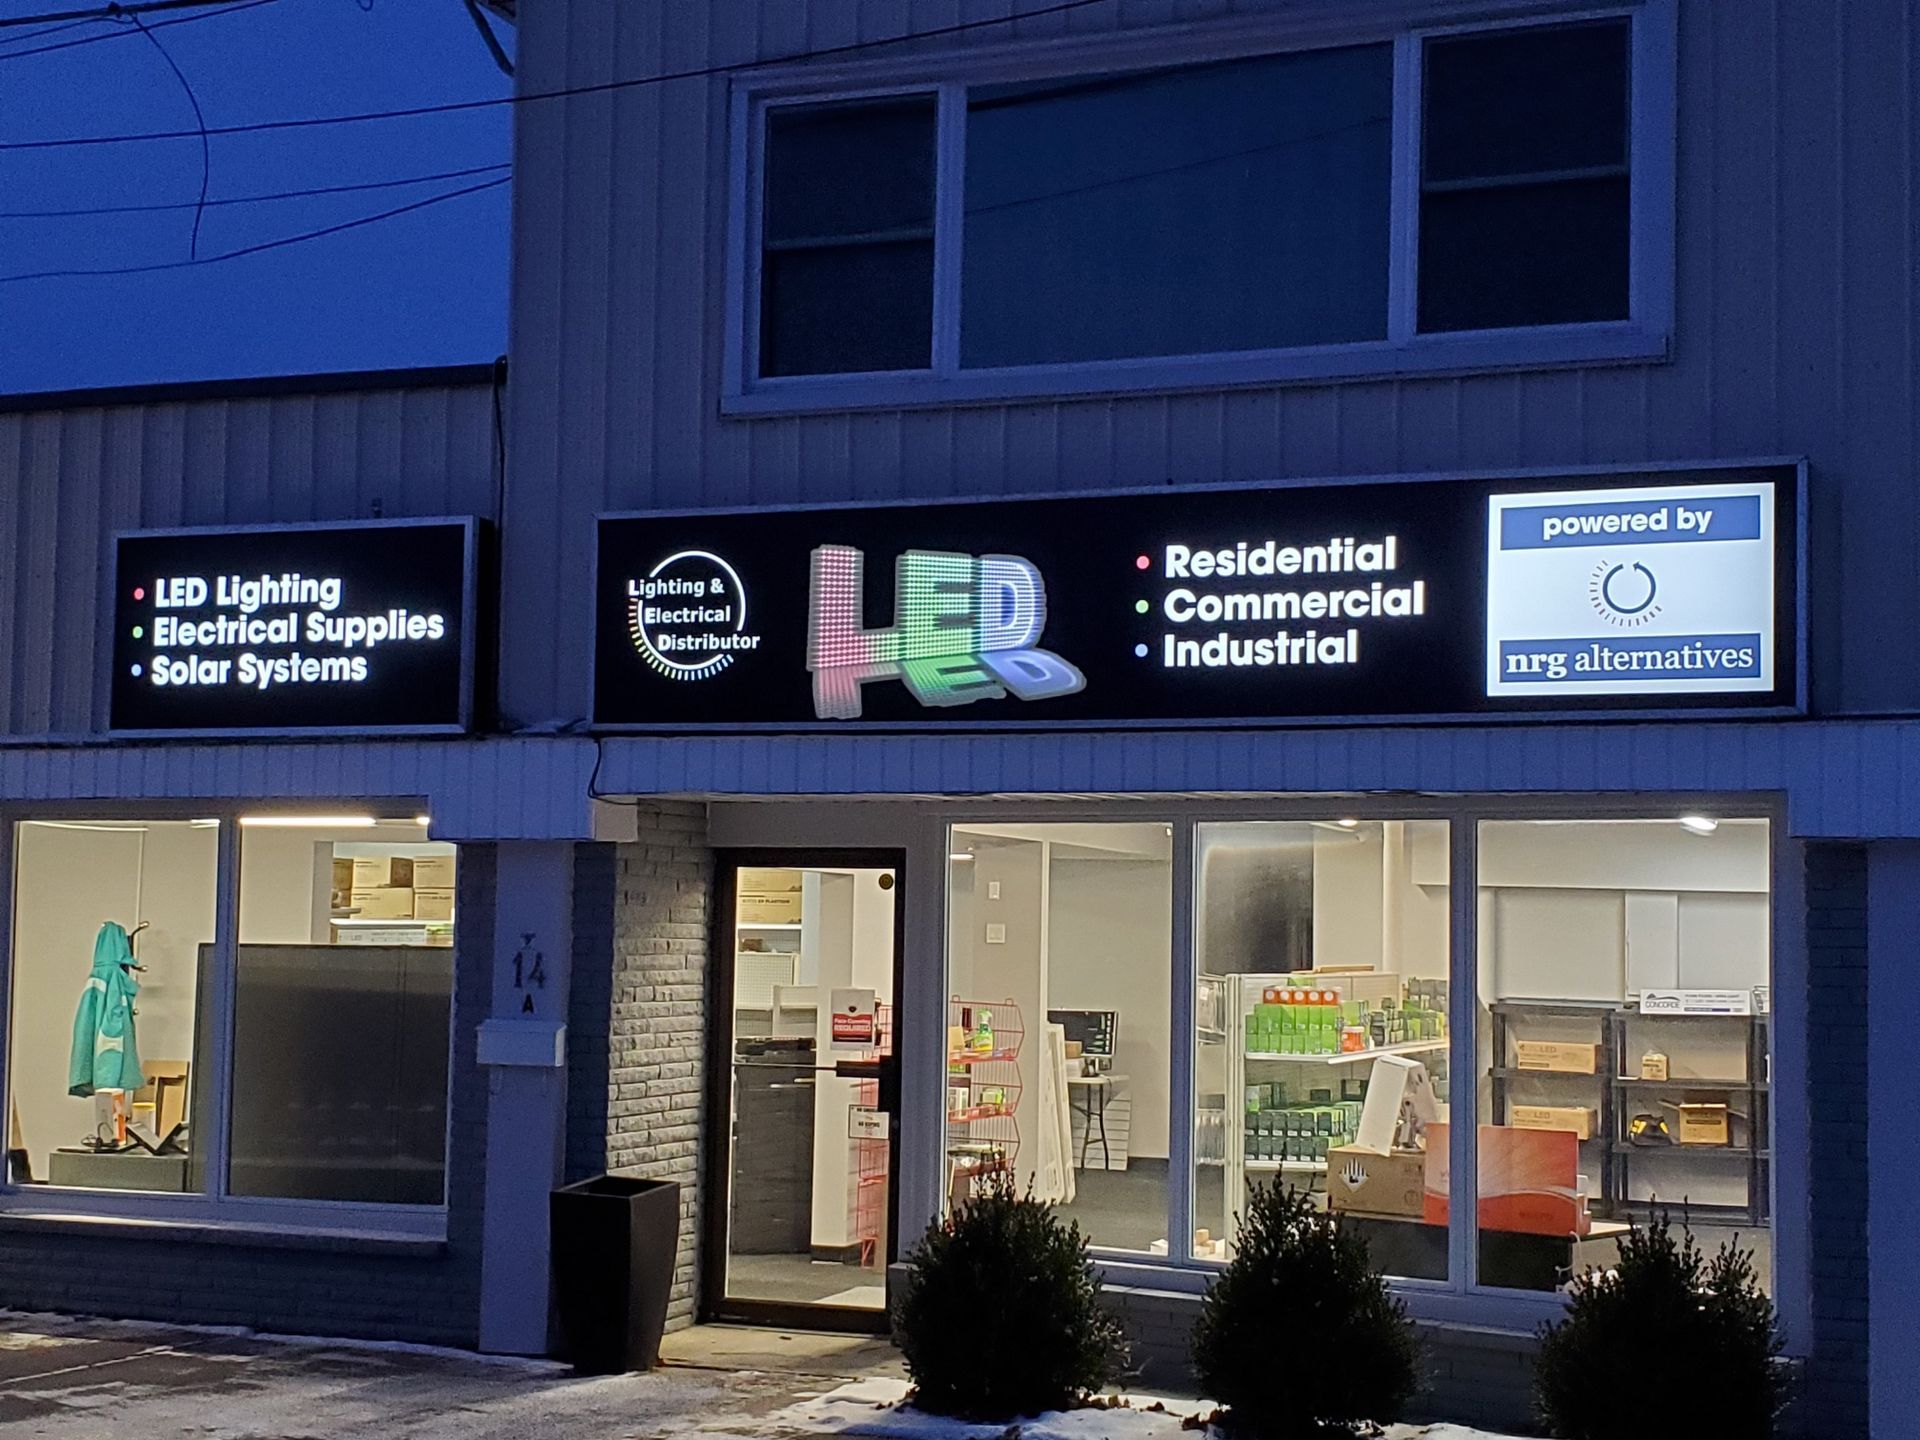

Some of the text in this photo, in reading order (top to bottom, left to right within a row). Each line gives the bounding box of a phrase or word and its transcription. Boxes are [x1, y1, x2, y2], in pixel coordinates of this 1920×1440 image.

[1543, 506, 1713, 541] powered by
[1164, 534, 1398, 579] Residential
[154, 573, 343, 612] LED Lighting
[628, 577, 725, 599] Lighting &
[808, 544, 1047, 671] LED
[1162, 579, 1426, 623] Commercial
[152, 608, 446, 649] Electrical Supplies
[644, 605, 731, 625] Electrical
[657, 633, 761, 652] Distributor
[1163, 627, 1359, 668] Industrial
[1506, 642, 1754, 679] nrg alternatives
[150, 651, 369, 691] Solar Systems
[512, 951, 545, 989] 14
